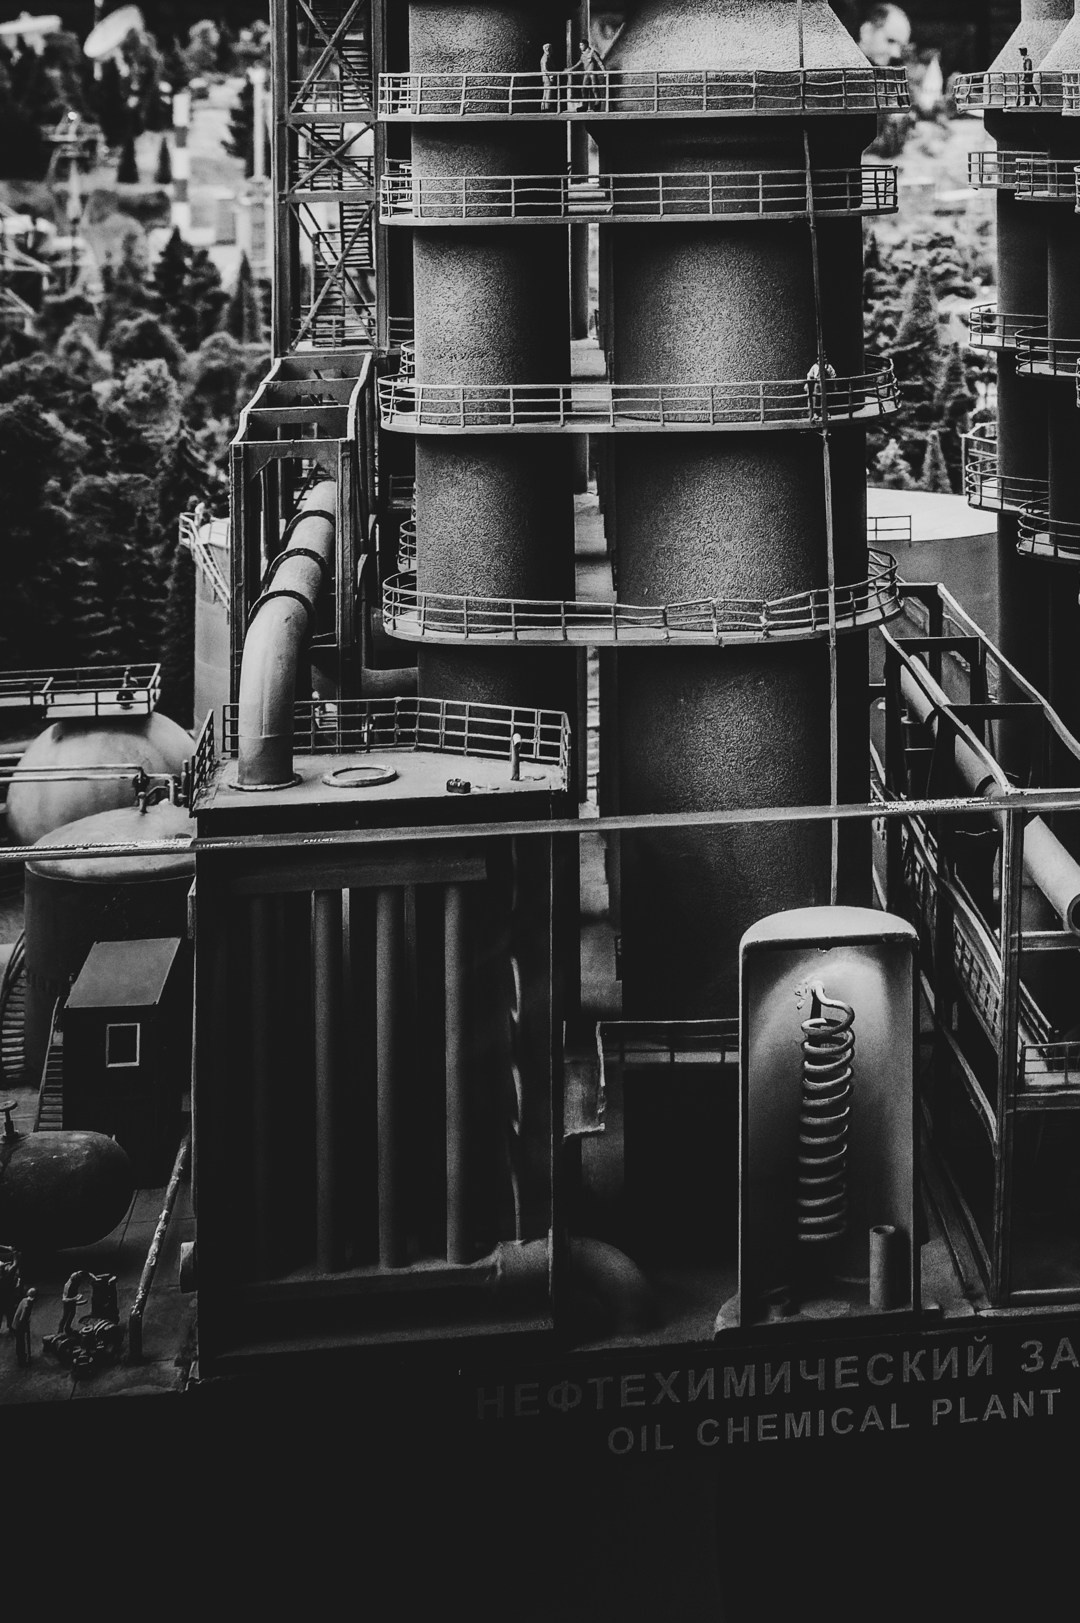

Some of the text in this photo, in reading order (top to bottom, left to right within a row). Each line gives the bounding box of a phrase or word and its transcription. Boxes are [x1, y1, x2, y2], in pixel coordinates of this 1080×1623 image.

[476, 1335, 993, 1420] НЕФТЕХИМИЧЕСКИЙ
[607, 1387, 1061, 1455] OIL CHEMICAL PLANT
